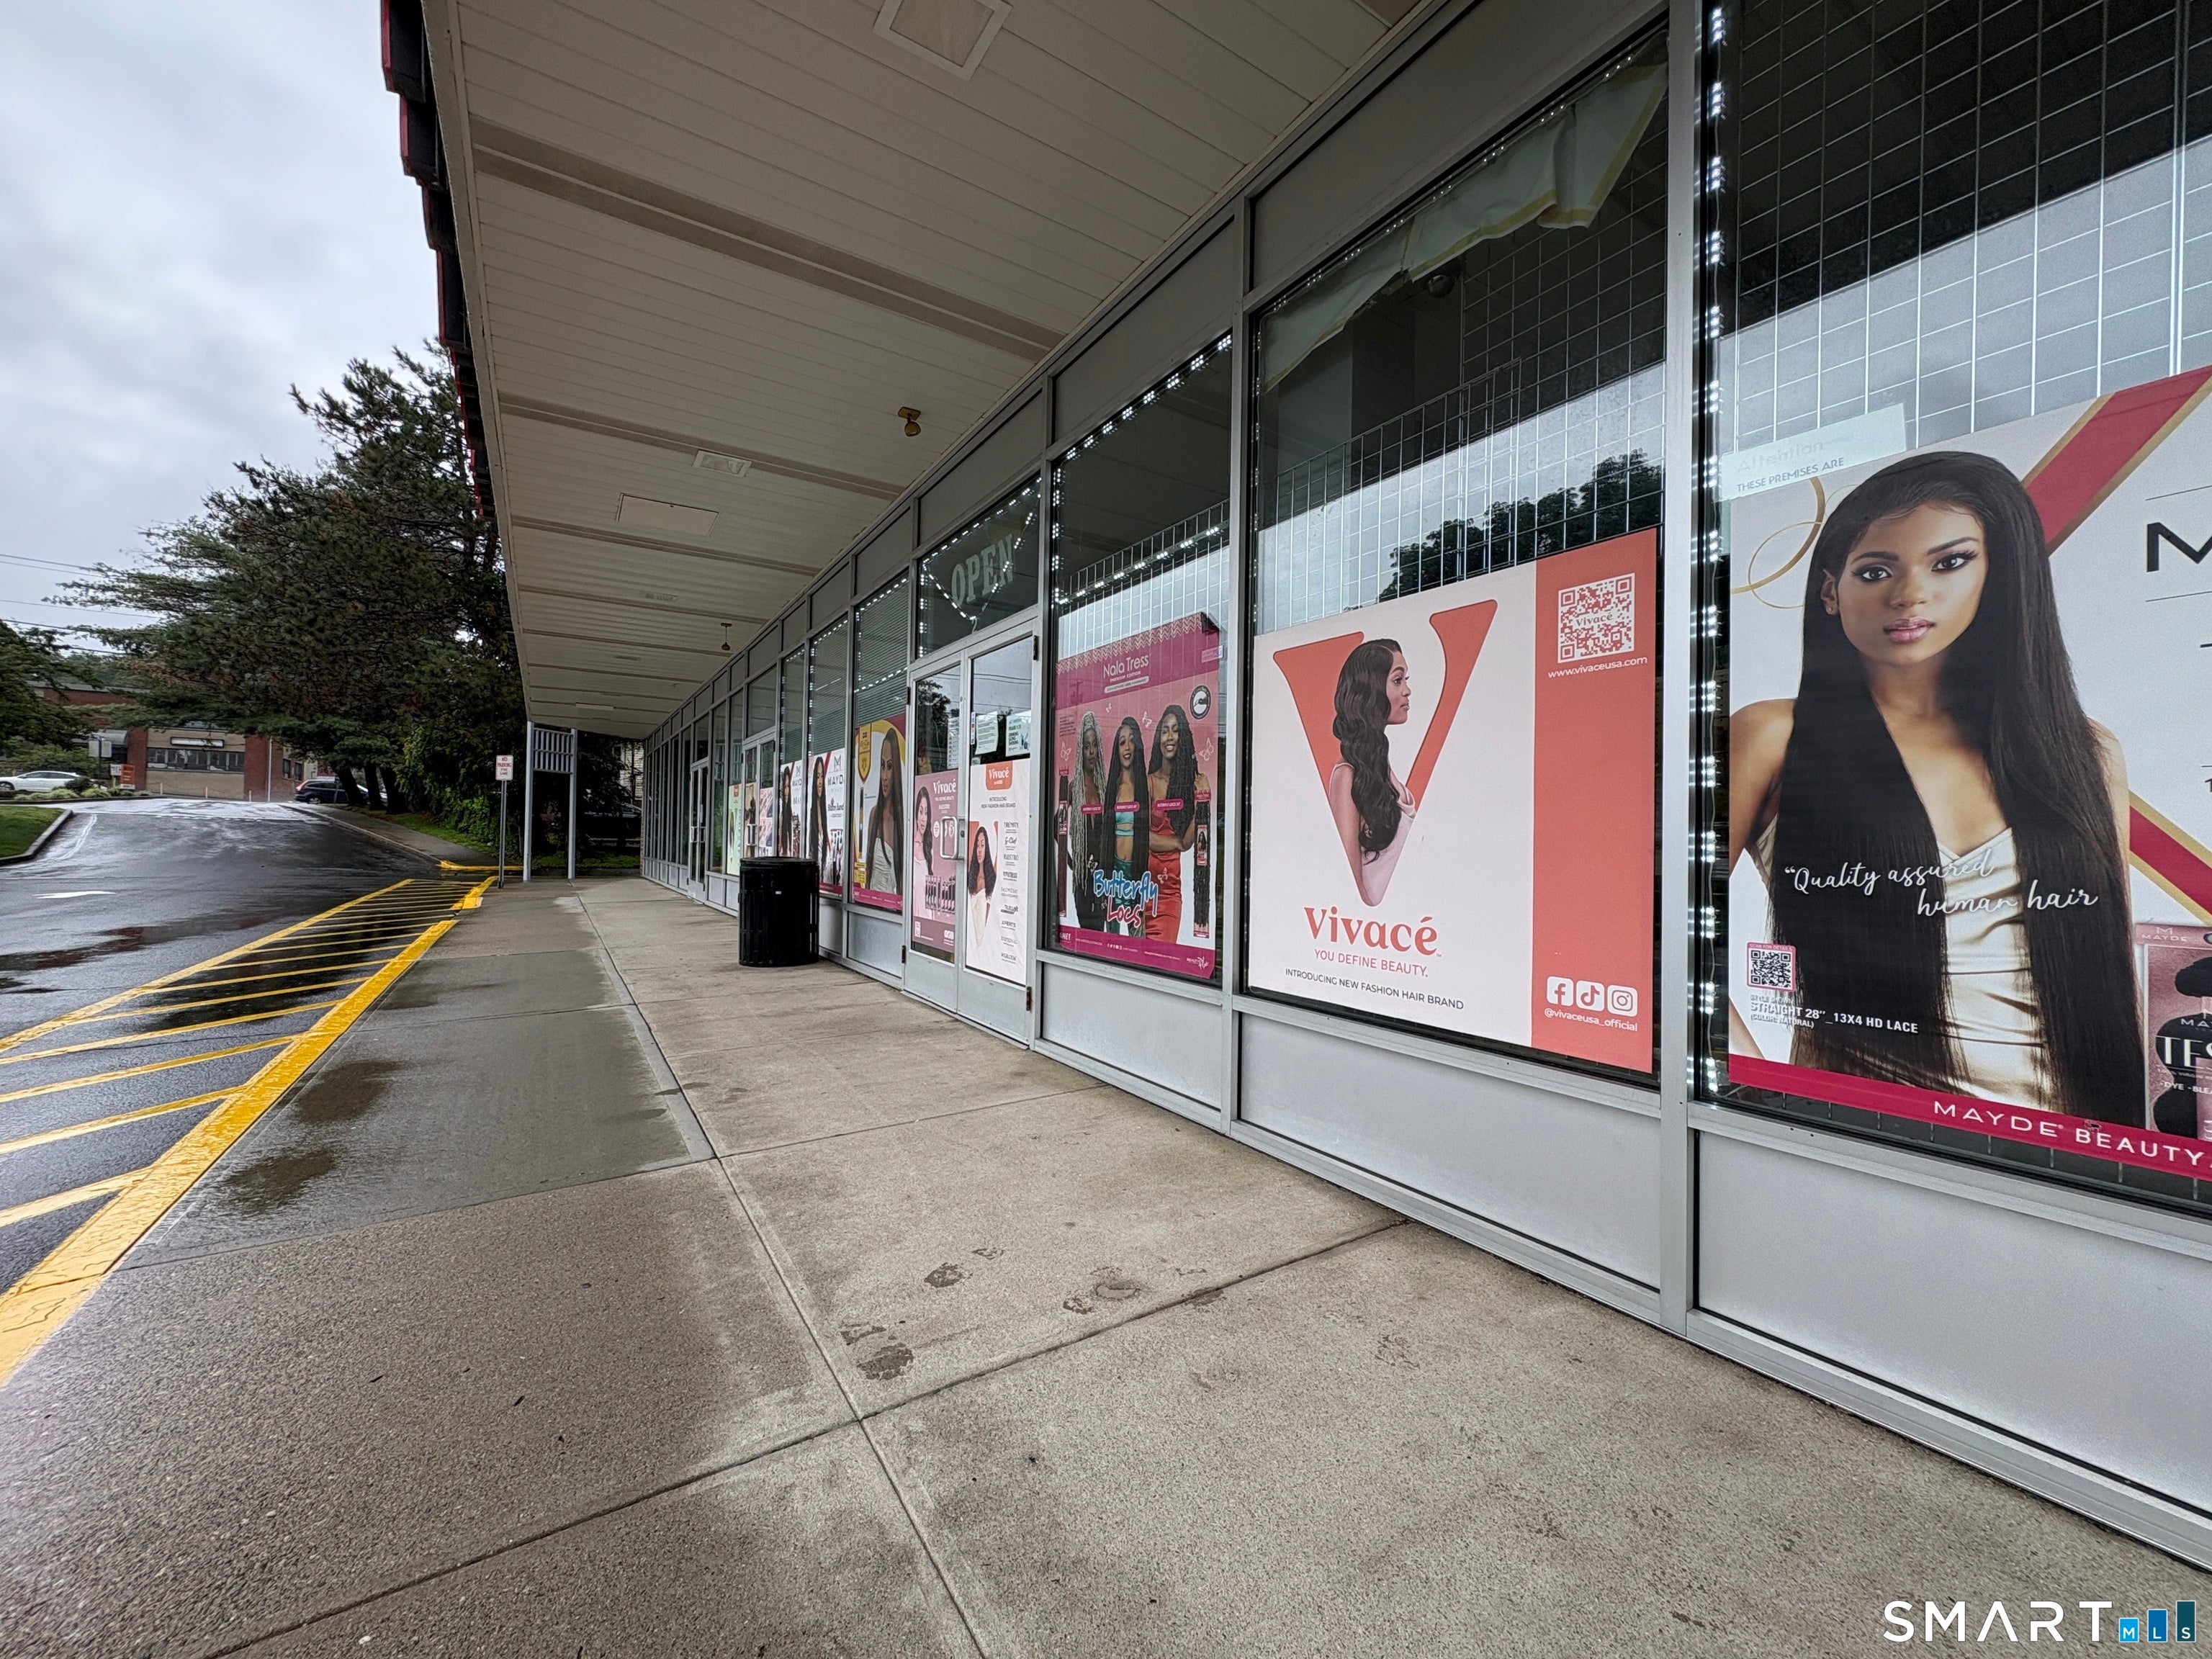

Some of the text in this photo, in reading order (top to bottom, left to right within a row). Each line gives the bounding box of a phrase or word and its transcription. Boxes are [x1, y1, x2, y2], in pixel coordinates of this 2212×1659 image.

[1737, 457, 1845, 492] THESE PREMISES ARE
[951, 534, 1013, 606] OPEN
[1575, 612, 1613, 626] Vivacé
[1103, 655, 1149, 679] Nala Tress
[1548, 657, 1647, 678] www.vivaceusa.com
[933, 778, 957, 794] Vivacé
[989, 767, 1010, 780] Vivacé
[1888, 849, 1994, 886] assured
[1093, 869, 1159, 917] Butterfly
[1917, 879, 2100, 917] human hair
[1107, 895, 1141, 928] Locs
[1304, 906, 1438, 956] Vivacé
[2142, 934, 2188, 943] MAYDE
[1315, 949, 1429, 977] YOU DEFINE BEAUTY.
[1285, 968, 1465, 1010] INTRODUCING NEW FASHION HAIR BRAND
[1545, 1007, 1638, 1032] @vivaceusa_official
[1866, 1017, 1883, 1028] HD
[1887, 1020, 1919, 1033] LACE
[2181, 1018, 2212, 1028] MA
[2076, 1128, 2205, 1166] BEAUTY
